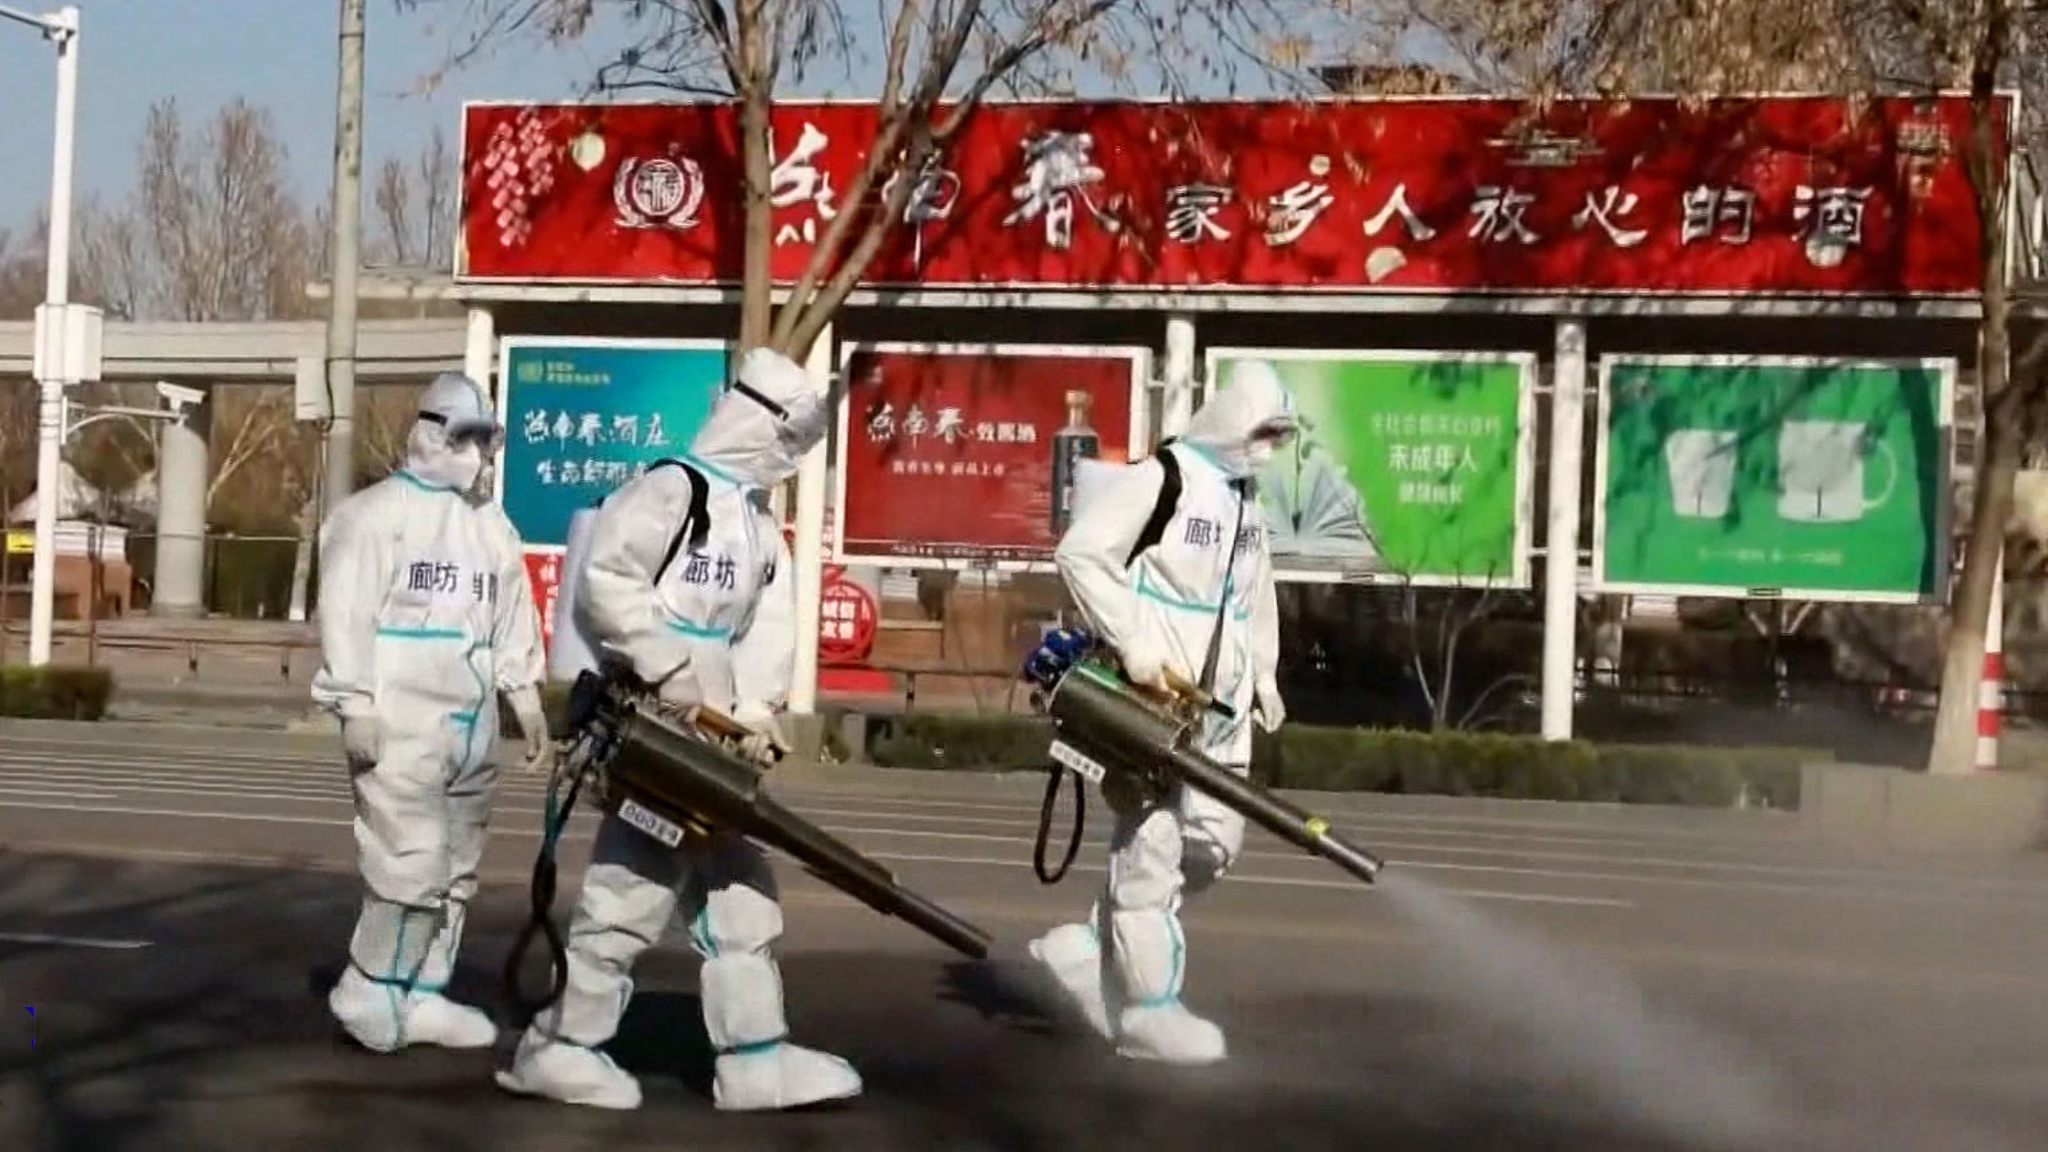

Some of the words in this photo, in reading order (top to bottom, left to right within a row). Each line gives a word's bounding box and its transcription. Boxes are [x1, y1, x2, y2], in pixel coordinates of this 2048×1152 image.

[1165, 182, 1873, 248] 家乡人放心的酒
[408, 560, 459, 592] 廊坊
